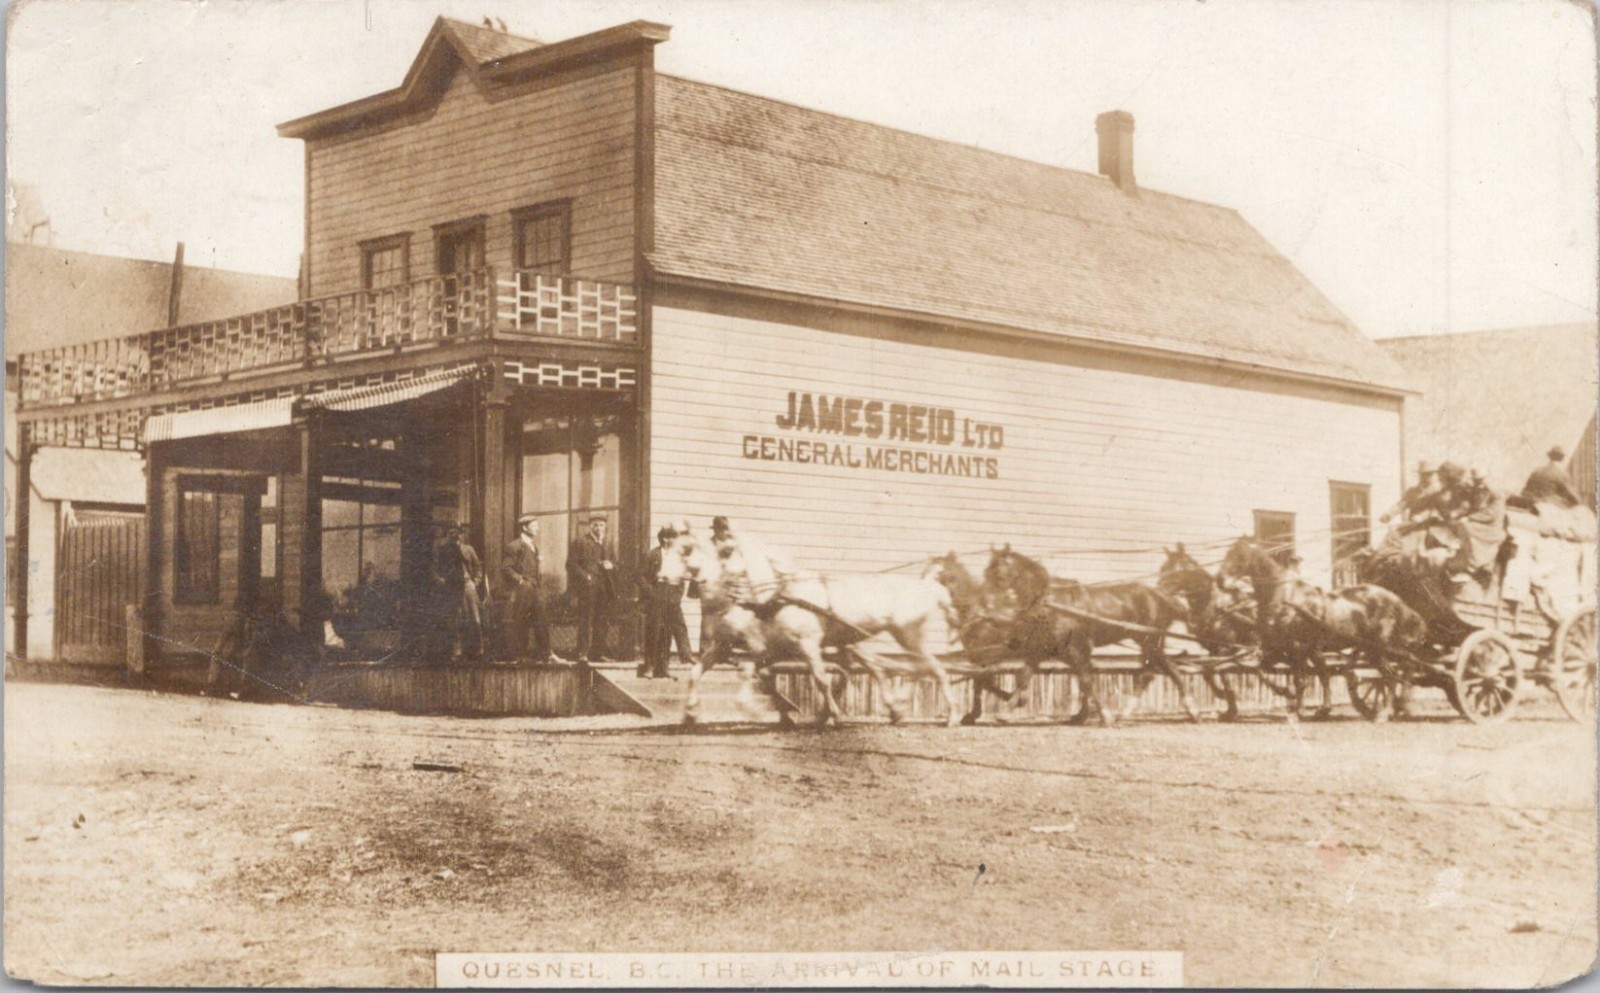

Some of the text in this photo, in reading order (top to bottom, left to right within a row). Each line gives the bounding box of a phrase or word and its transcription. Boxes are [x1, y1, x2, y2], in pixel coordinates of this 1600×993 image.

[776, 391, 1004, 450] JAMES REID LTD
[742, 435, 999, 480] GENERAL MERCHANTS
